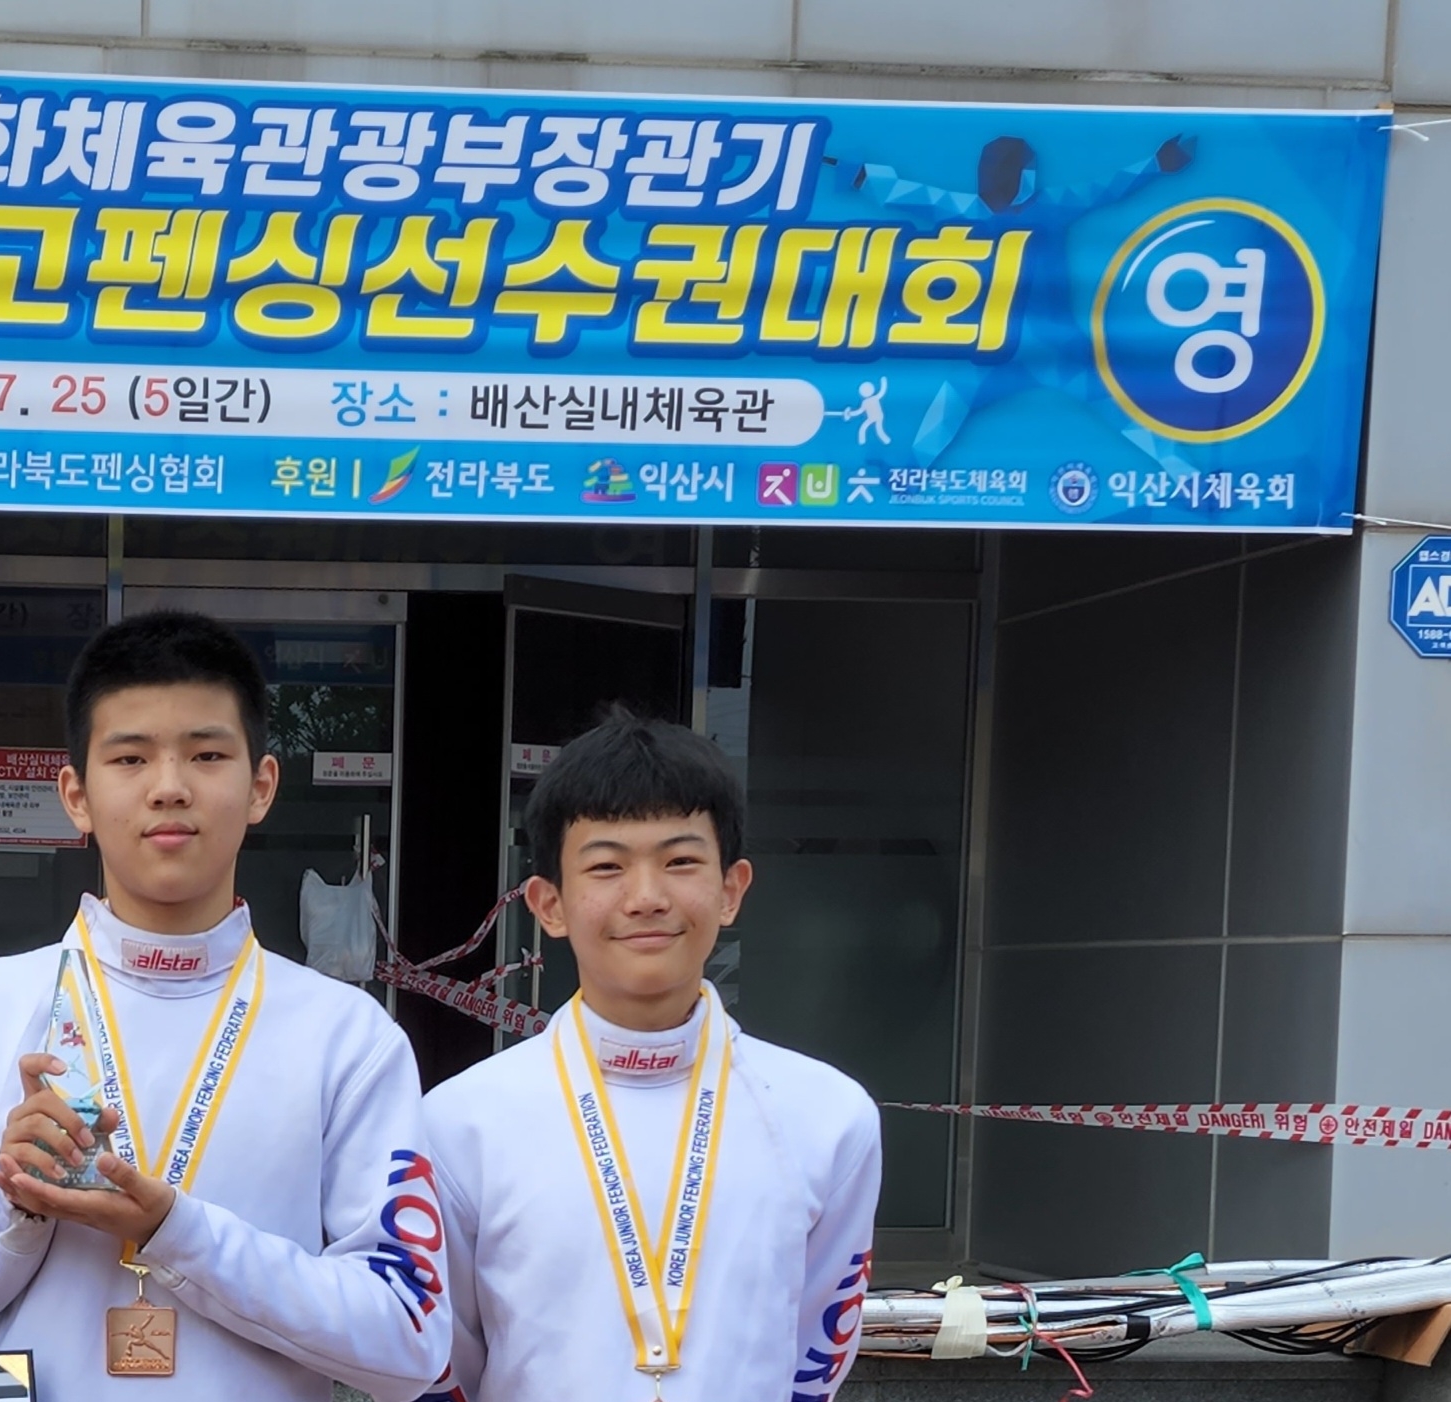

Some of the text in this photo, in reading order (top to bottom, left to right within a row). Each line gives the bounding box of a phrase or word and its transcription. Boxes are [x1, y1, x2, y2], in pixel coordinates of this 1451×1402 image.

[1144, 246, 1266, 395] 영
[51, 375, 106, 415] 25
[128, 375, 272, 425] (5일간)
[331, 381, 417, 427] 장소
[470, 383, 775, 434] 배산실내체육관
[271, 457, 337, 498] 후원
[425, 460, 555, 498] 전라북도
[639, 461, 734, 502] 익산시
[888, 468, 1028, 494] 전라북도체육회
[1108, 470, 1295, 510] 익산시체육회
[7, 753, 70, 767] 배산실내체육
[25, 766, 47, 780] 설치
[135, 947, 202, 972] allstar
[503, 1008, 526, 1031] 위험
[612, 1048, 680, 1071] allstar
[167, 997, 248, 1186] KOREA JUNIOR FENCING FEDERATION
[1119, 1111, 1189, 1127] 안전제일
[1274, 1113, 1308, 1132] 위험
[1344, 1115, 1413, 1139] 안전제일
[578, 1092, 648, 1288] KOREA JUNIOR FENCING FEDERATION
[667, 1088, 715, 1287] KOREA JUNIOR FENCING FEDERATION
